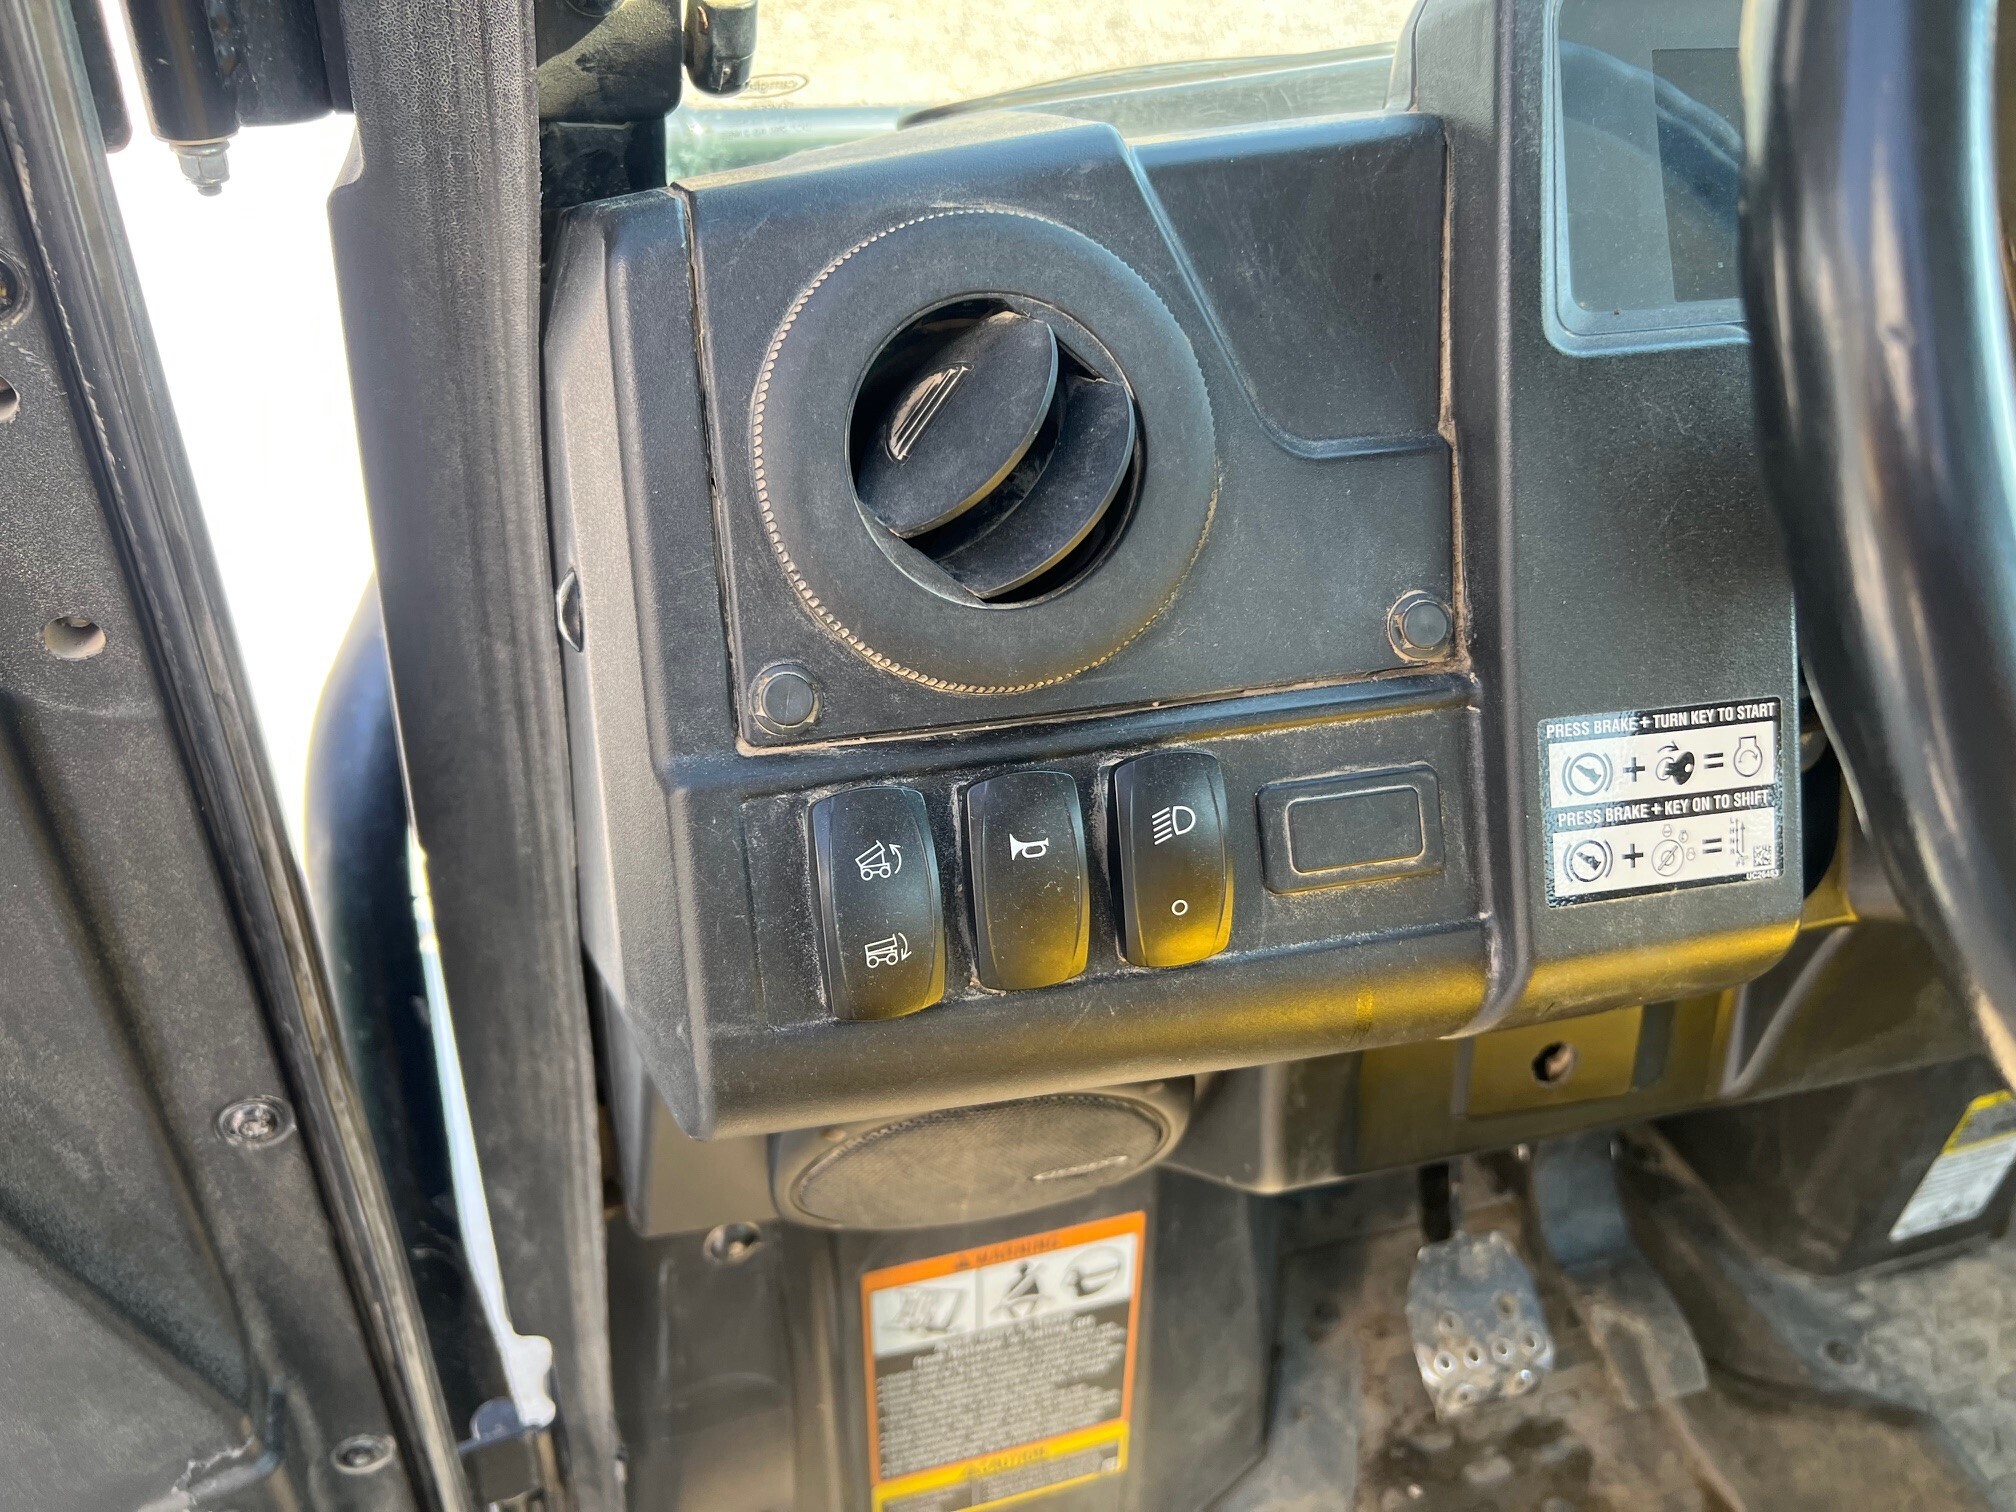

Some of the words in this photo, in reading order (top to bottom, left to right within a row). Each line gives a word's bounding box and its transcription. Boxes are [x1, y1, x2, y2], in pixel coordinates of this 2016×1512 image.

[1546, 721, 1590, 739] PRESS
[1594, 716, 1640, 735] BRAKE
[1653, 711, 1688, 729] TURN
[1690, 708, 1715, 726] KEY
[1717, 705, 1734, 722] TO
[1737, 701, 1776, 720] START
[1558, 808, 1602, 828] PRESS
[1605, 803, 1650, 822] BRAKE
[1664, 799, 1689, 816] KEY
[1692, 796, 1710, 813] ON
[1713, 793, 1730, 810] TO
[1733, 789, 1770, 808] SHIFT
